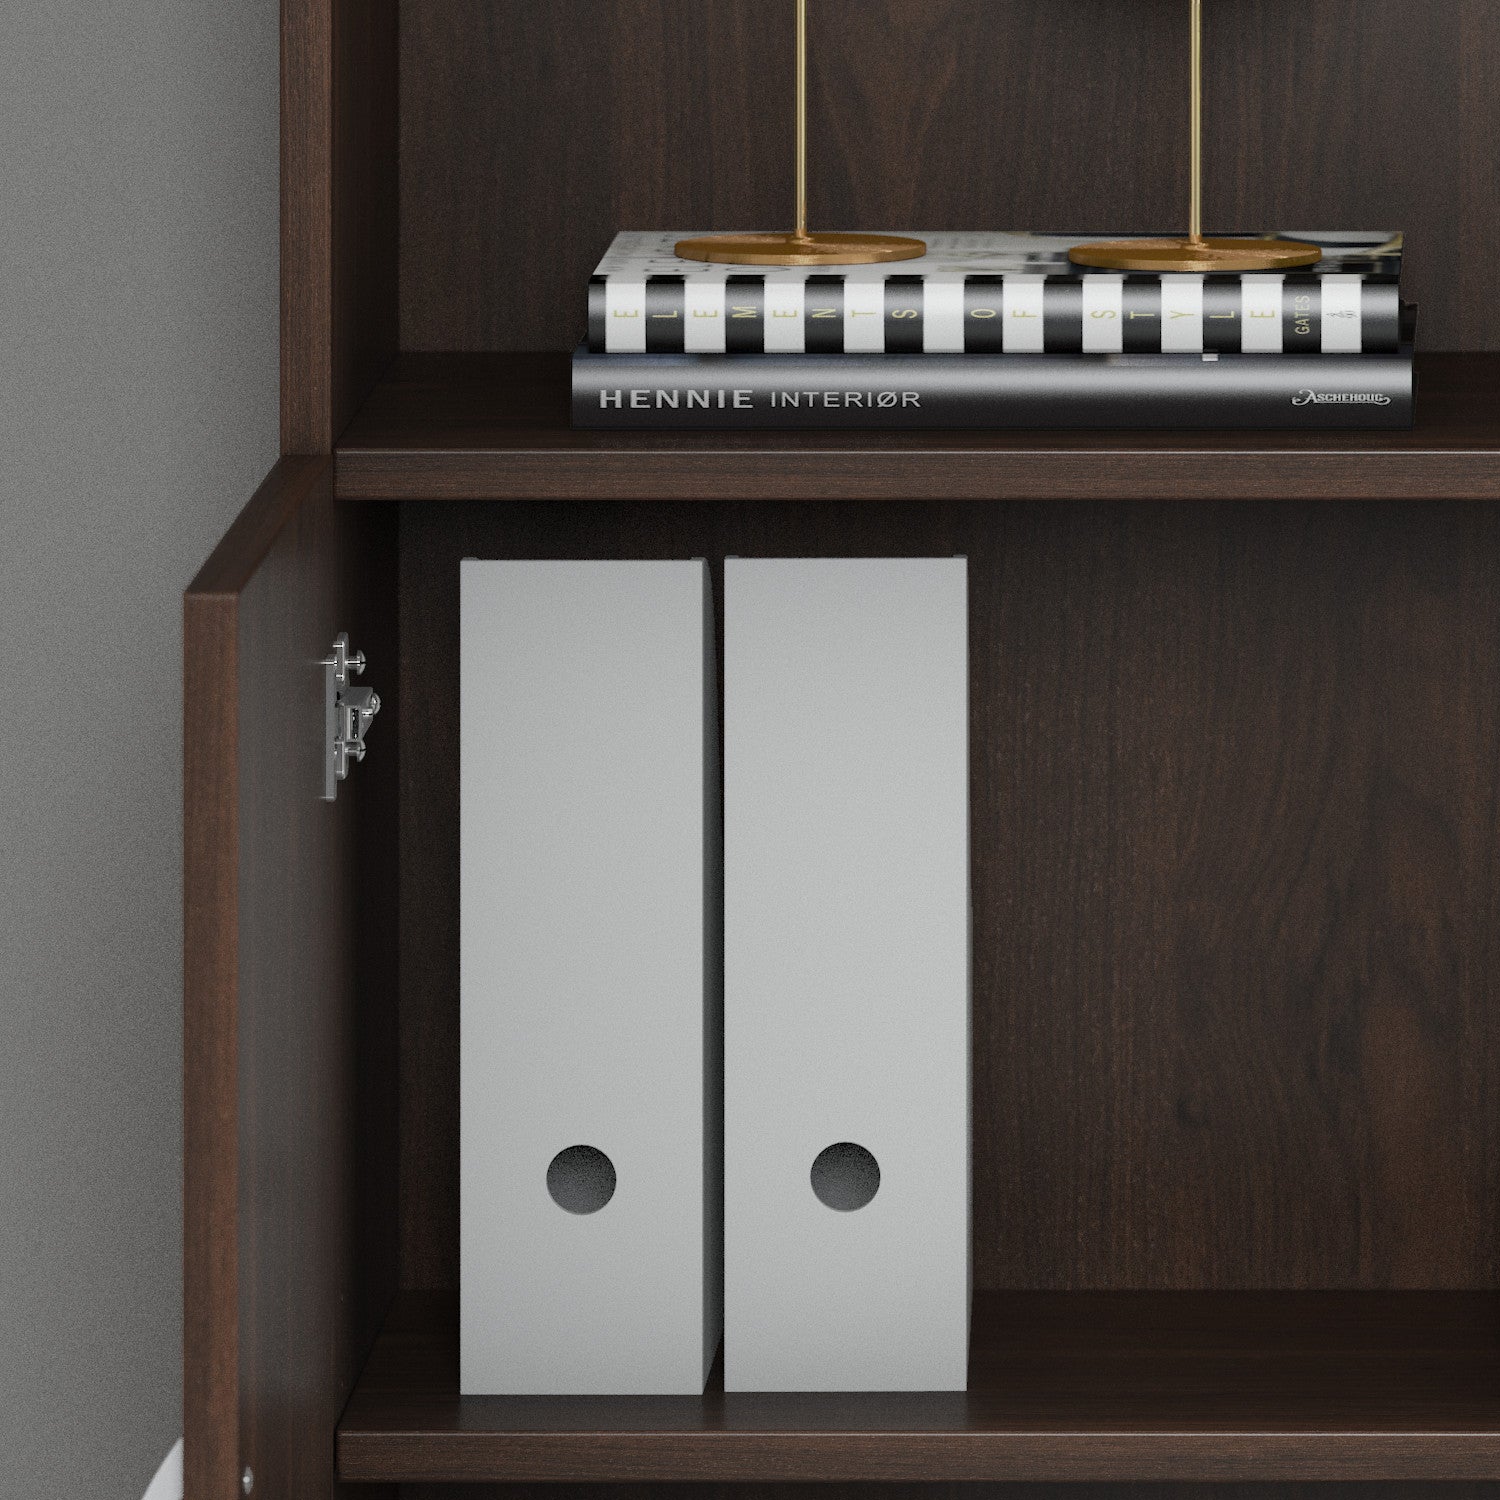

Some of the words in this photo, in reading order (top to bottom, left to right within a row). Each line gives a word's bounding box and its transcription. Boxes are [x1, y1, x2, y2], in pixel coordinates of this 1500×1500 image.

[1294, 295, 1311, 335] GATES
[600, 389, 754, 409] HENNIE
[770, 391, 921, 408] INTERIØR
